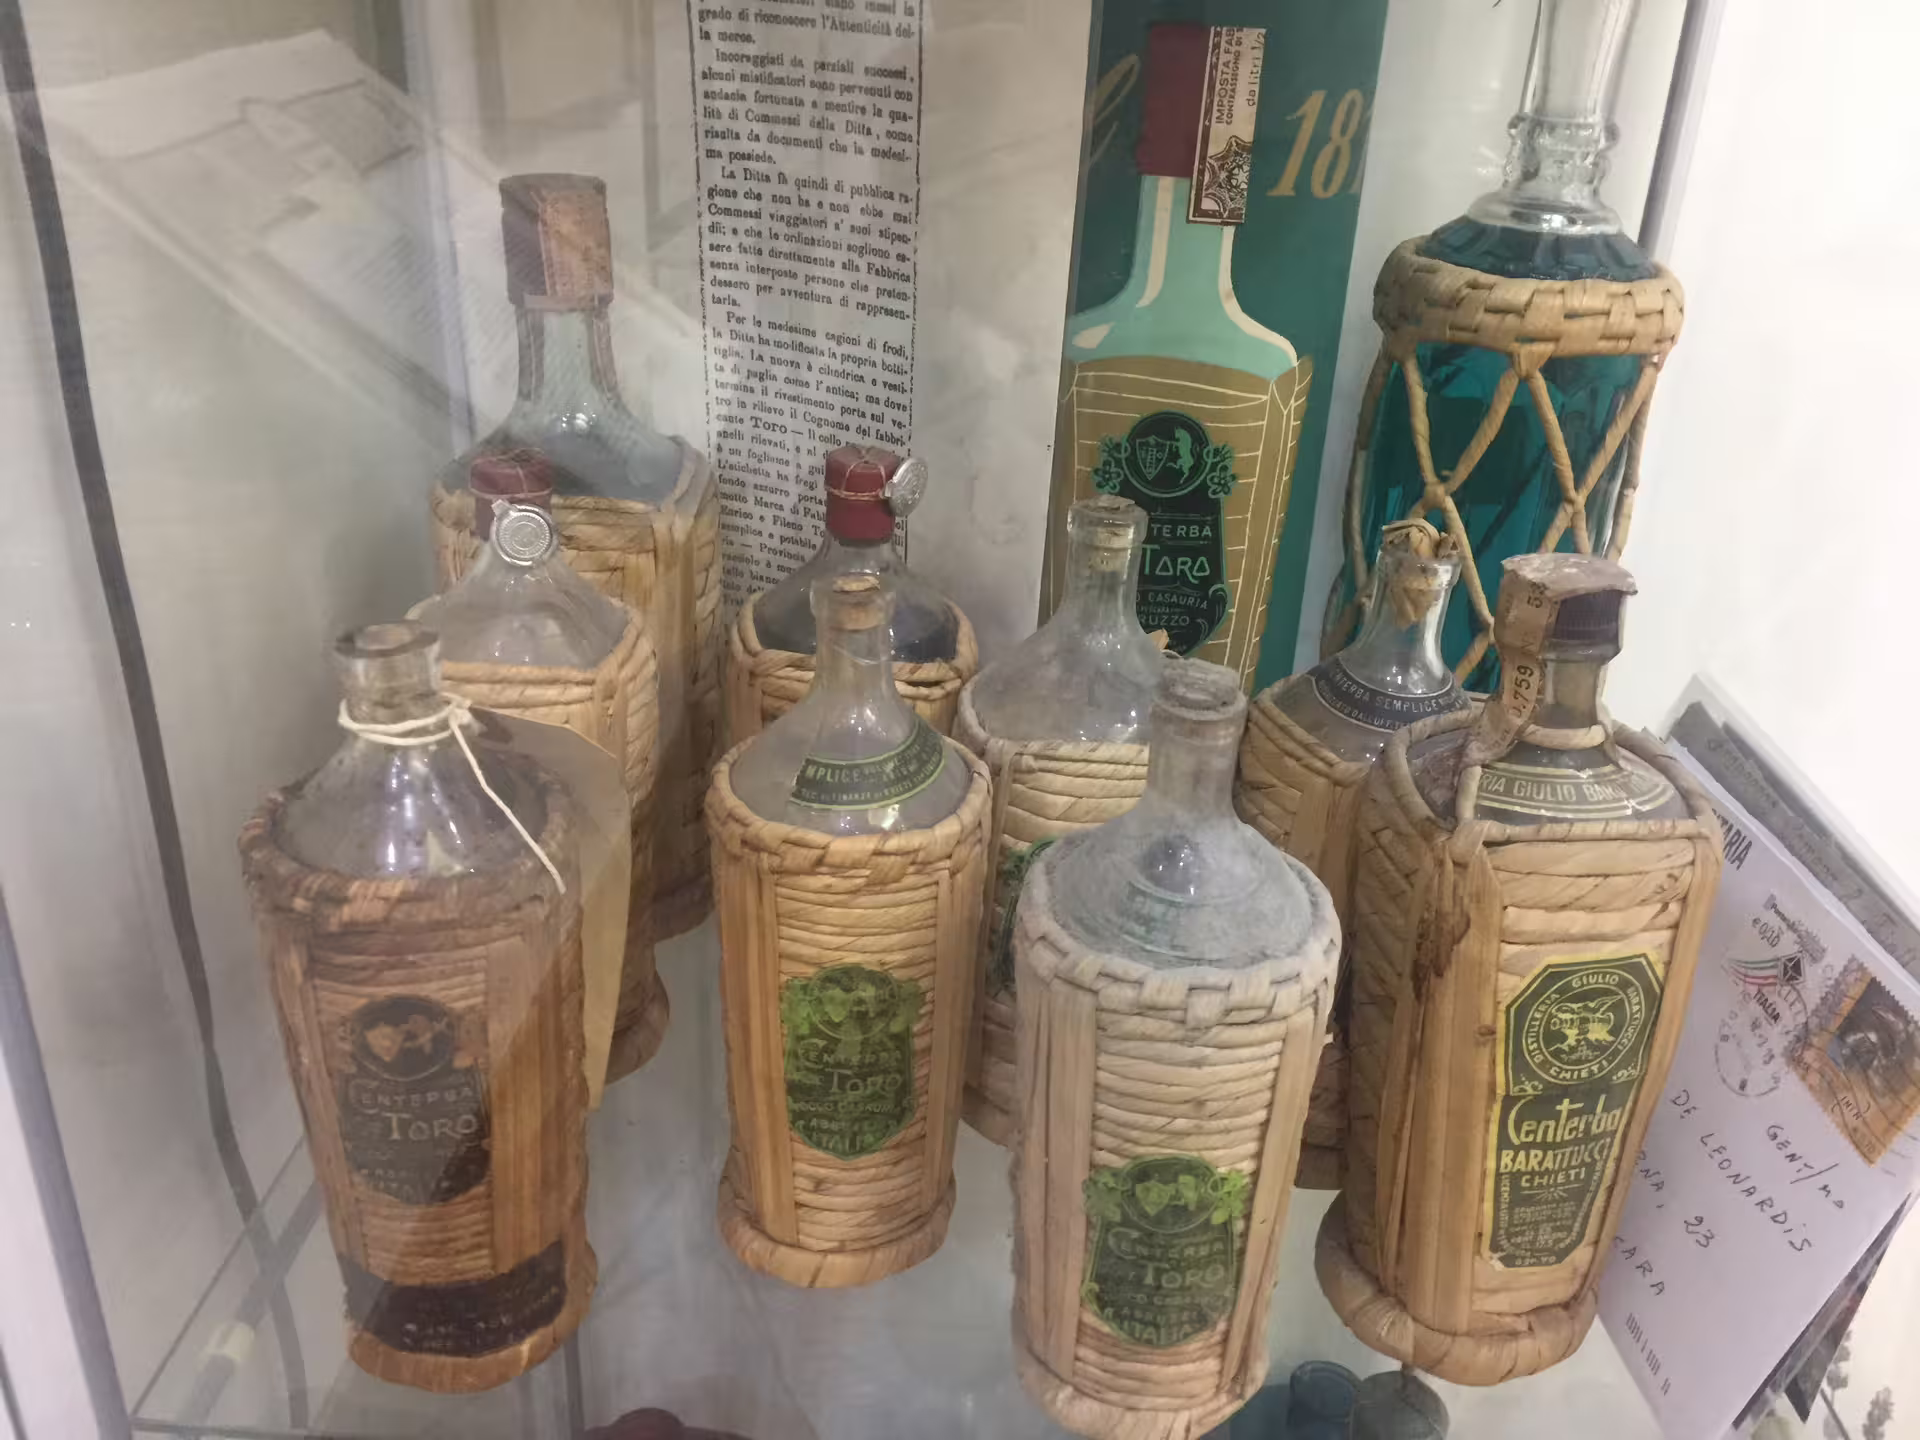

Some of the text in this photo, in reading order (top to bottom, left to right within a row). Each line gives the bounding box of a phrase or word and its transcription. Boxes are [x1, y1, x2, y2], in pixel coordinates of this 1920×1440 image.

[698, 6, 732, 23] grado
[739, 8, 749, 22] di
[814, 58, 854, 75] parziali
[702, 67, 735, 82] alcuni
[810, 80, 835, 92] sono
[840, 81, 891, 99] pervenuti
[894, 89, 912, 101] con
[1215, 61, 1232, 125] IMPOSTA
[1225, 50, 1241, 126] CONTRASSEGNO
[728, 107, 739, 121] di
[810, 114, 835, 131] della
[825, 101, 867, 116] mentire
[873, 103, 882, 118] la
[705, 126, 740, 141] risulta
[747, 129, 760, 142] da
[767, 130, 823, 149] documenti
[743, 167, 771, 183] Ditta
[795, 176, 828, 191] quindi
[834, 180, 844, 193] di
[851, 183, 894, 200] pubblica
[707, 185, 737, 201] gione
[743, 188, 762, 201] che
[771, 194, 791, 205] non
[829, 202, 849, 213] non
[708, 203, 761, 220] Commessi
[850, 220, 871, 236] suoi
[744, 226, 762, 239] che
[842, 257, 860, 273] alla
[867, 261, 911, 283] Fabbrica
[757, 282, 773, 296] per
[781, 288, 832, 304] avventura
[840, 295, 849, 308] di
[867, 339, 876, 351] di
[770, 355, 801, 369] nuova
[761, 385, 768, 397] il
[774, 389, 835, 411] rivestimento
[841, 404, 866, 420] porta
[870, 410, 884, 424] sul
[866, 393, 880, 404] ma
[884, 398, 907, 413] dove
[750, 416, 788, 434] Toro
[819, 433, 842, 447] collo
[790, 407, 797, 419] il
[803, 411, 850, 432] Cognome
[856, 423, 871, 438] del
[754, 495, 785, 512] Marca
[779, 534, 817, 551] potabile
[1151, 523, 1212, 537] TERBA
[759, 543, 805, 563] Provincia
[1148, 592, 1208, 610] CASAURIA
[1138, 615, 1190, 626] RUZZO
[1331, 668, 1370, 702] NTERBA
[1375, 695, 1438, 713] SEMPLICE
[1480, 773, 1505, 793] RIA
[1512, 781, 1577, 802] GIULIO
[1711, 808, 1753, 872] TARIA
[1753, 985, 1781, 1024] ITALIA
[1527, 993, 1560, 1064] DISTILLERIA
[1571, 974, 1620, 988] GIULIO
[1617, 985, 1642, 1051] BARATTUCCI
[1549, 1059, 1610, 1080] CHIETI
[1507, 1094, 1624, 1147] Centerba
[1500, 1137, 1614, 1174] BARATTUCCI
[1520, 1168, 1587, 1189] CHIETI
[1683, 1215, 1716, 1248] 23
